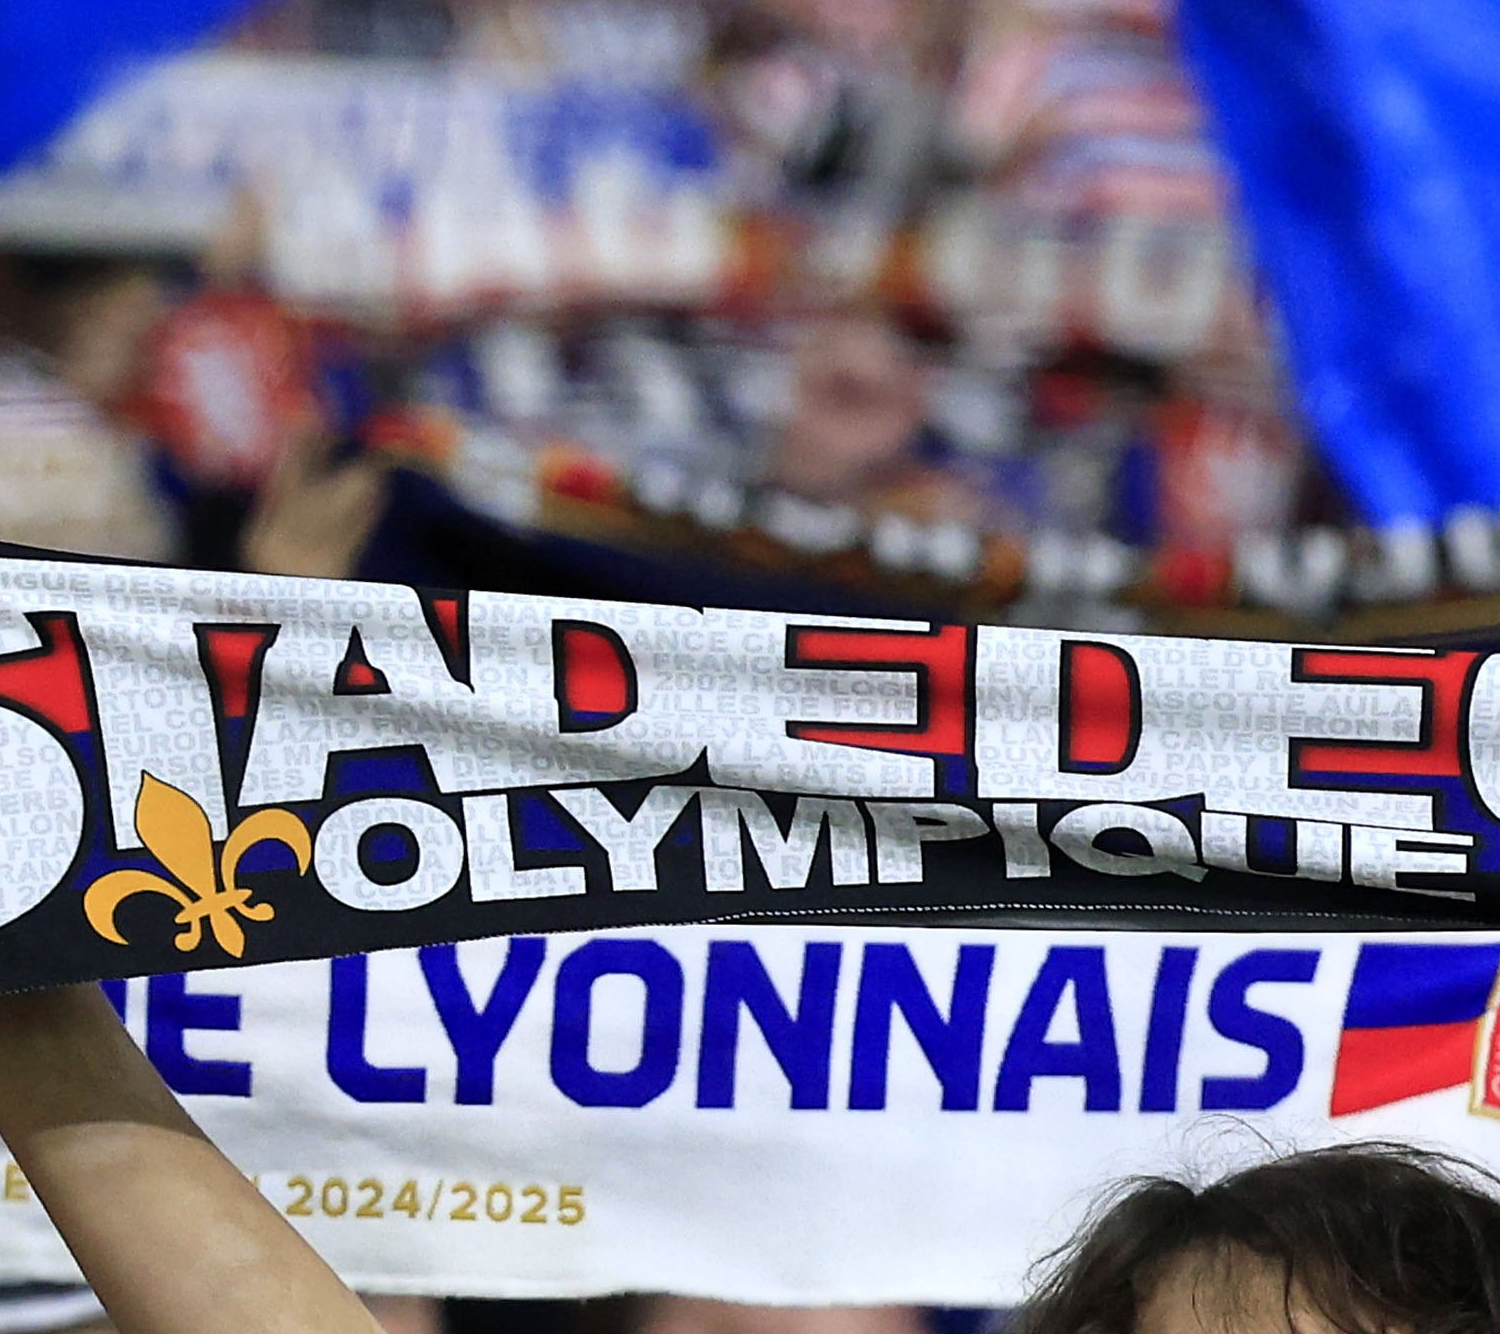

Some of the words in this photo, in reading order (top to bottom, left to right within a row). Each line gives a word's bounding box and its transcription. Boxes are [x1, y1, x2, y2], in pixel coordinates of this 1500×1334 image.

[104, 573, 176, 594] DES
[634, 629, 728, 652] ANCE
[653, 652, 784, 674] FRANC
[774, 695, 820, 717] DE
[977, 624, 1435, 831] DE
[1158, 730, 1287, 752] CAVEG
[1166, 753, 1256, 773] PAPY
[314, 785, 1474, 913] OLYMPIQUE
[323, 937, 1323, 1114] LYONNAIS
[286, 1176, 587, 1226] 2024/2025
